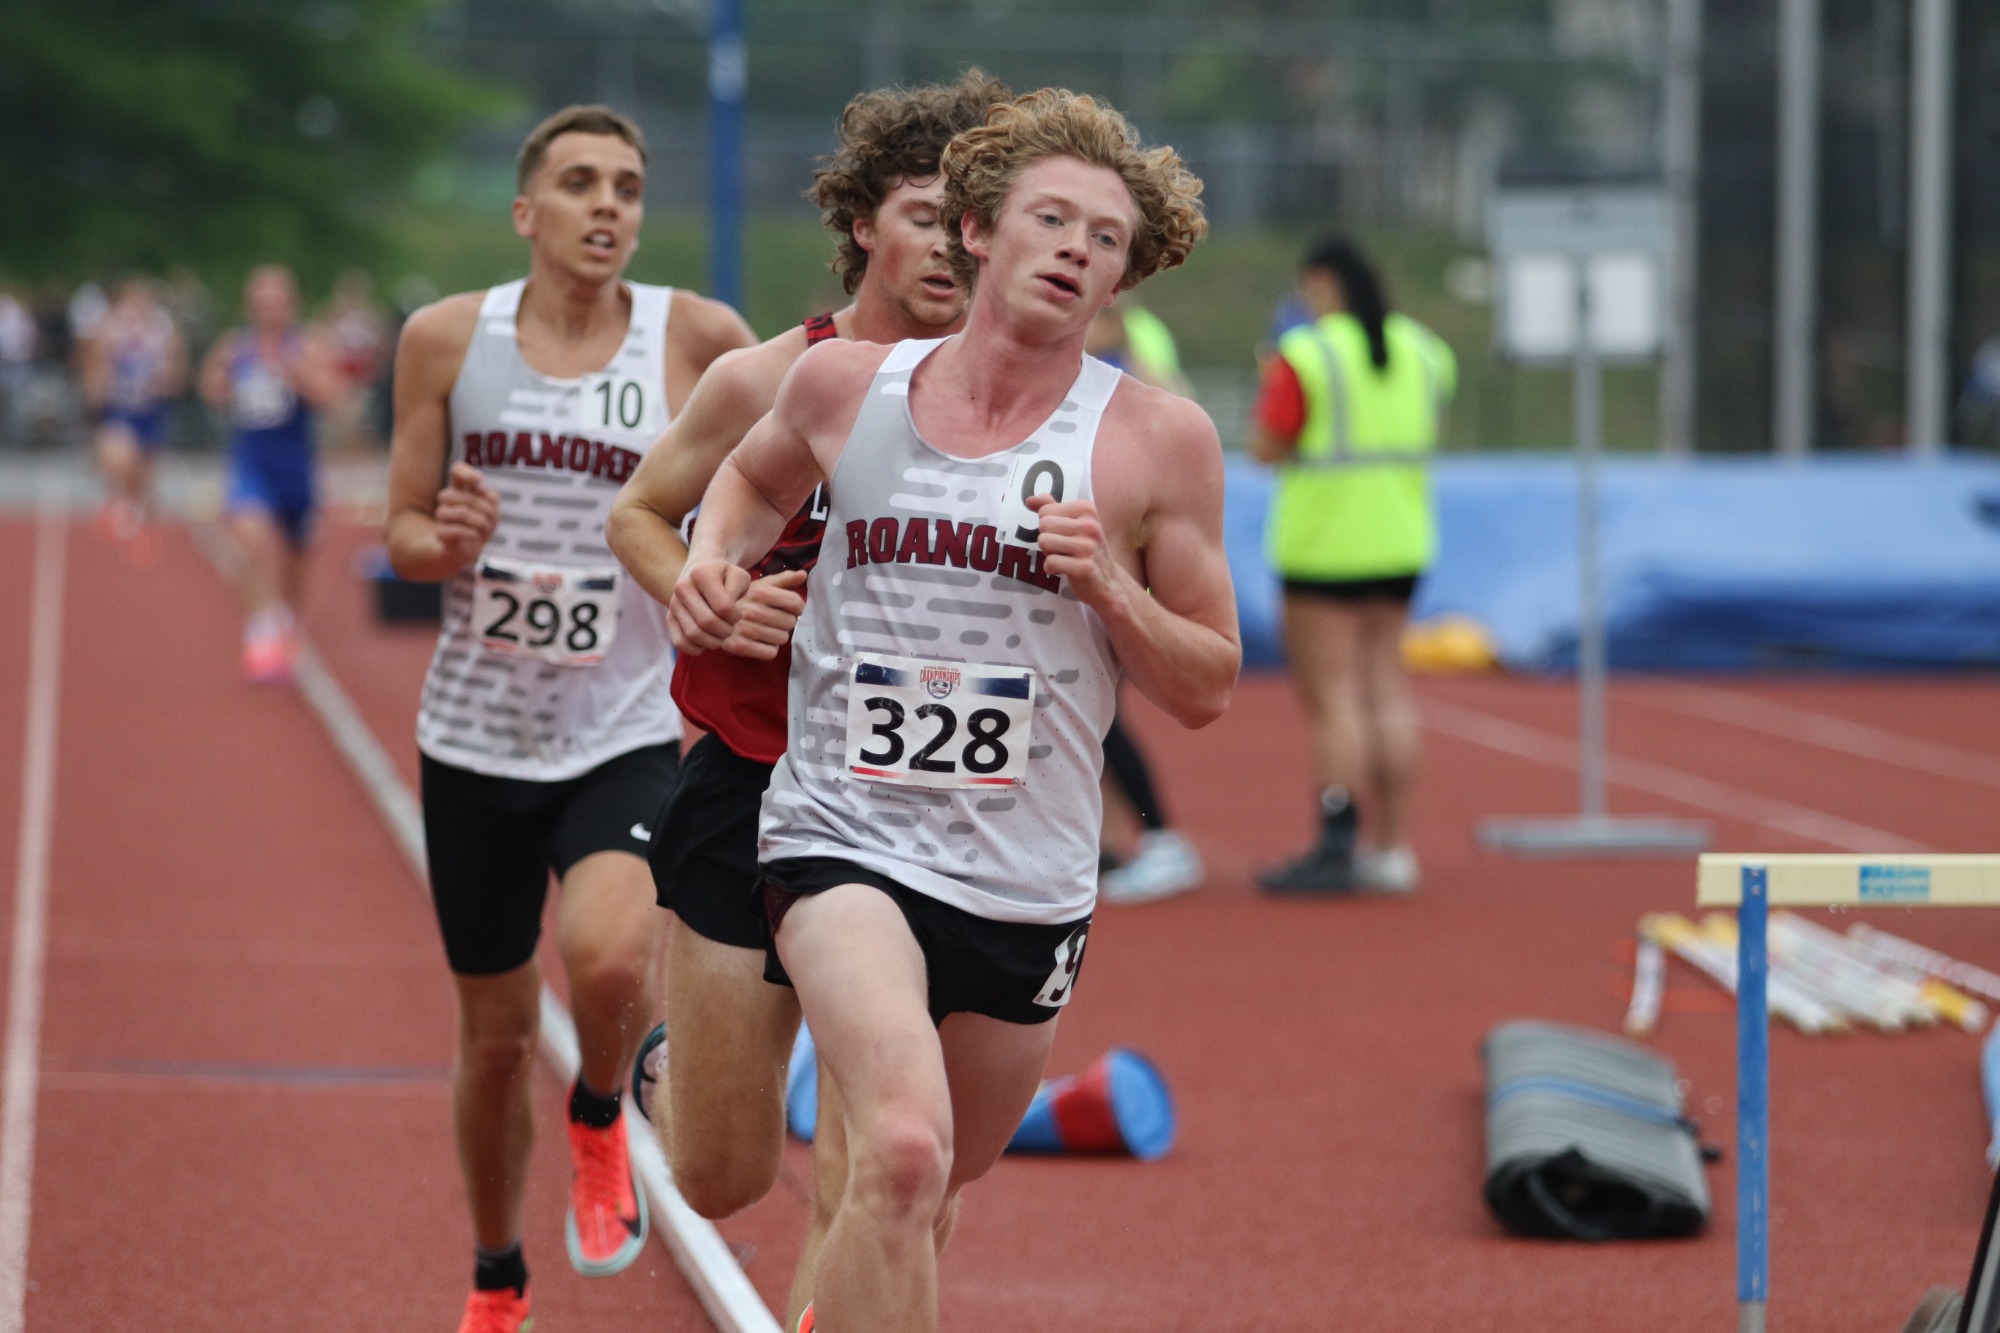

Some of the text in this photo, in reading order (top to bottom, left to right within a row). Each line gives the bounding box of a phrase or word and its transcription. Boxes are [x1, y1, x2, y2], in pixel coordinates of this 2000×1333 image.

[595, 380, 643, 428] 10
[464, 430, 642, 484] ROANOKE
[1015, 459, 1065, 543] 9
[485, 591, 600, 653] 298
[859, 696, 1011, 774] 328
